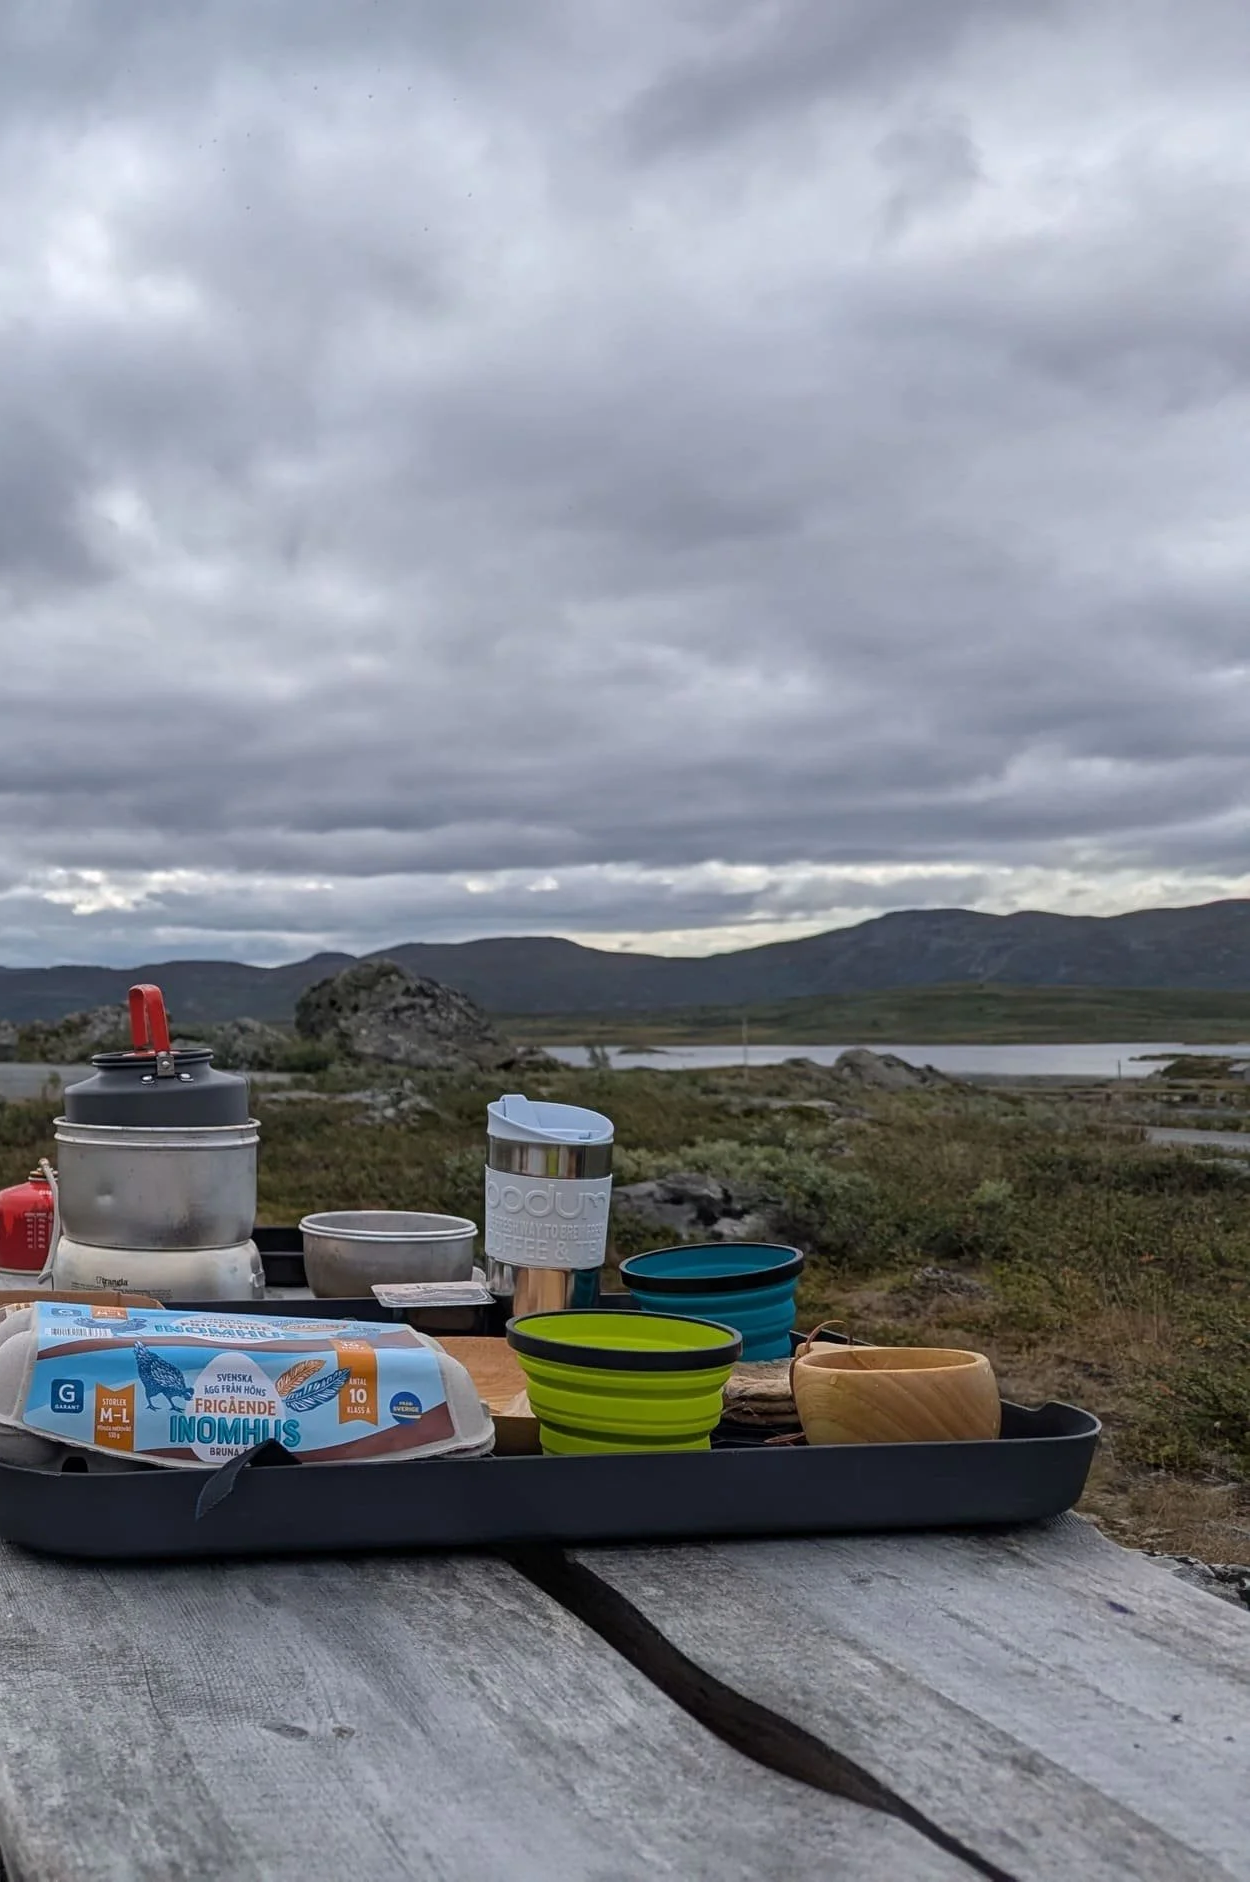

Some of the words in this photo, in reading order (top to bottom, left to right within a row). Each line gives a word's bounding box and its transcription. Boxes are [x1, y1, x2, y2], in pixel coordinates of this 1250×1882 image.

[544, 1223, 558, 1239] TO
[555, 1240, 572, 1262] &
[216, 1373, 253, 1383] SVENSKA
[349, 1378, 367, 1386] ANTAL
[58, 1384, 76, 1403] G
[204, 1385, 220, 1395] ÄGG
[221, 1383, 242, 1394] FRÅN
[244, 1385, 267, 1397] HÖNS
[349, 1388, 367, 1404] 10
[102, 1398, 127, 1407] STORLEK
[195, 1396, 276, 1416] FRIGÅENDE
[347, 1406, 365, 1414] KLASS
[169, 1415, 301, 1448] INOMHUS
[209, 1447, 239, 1457] BRUNA
